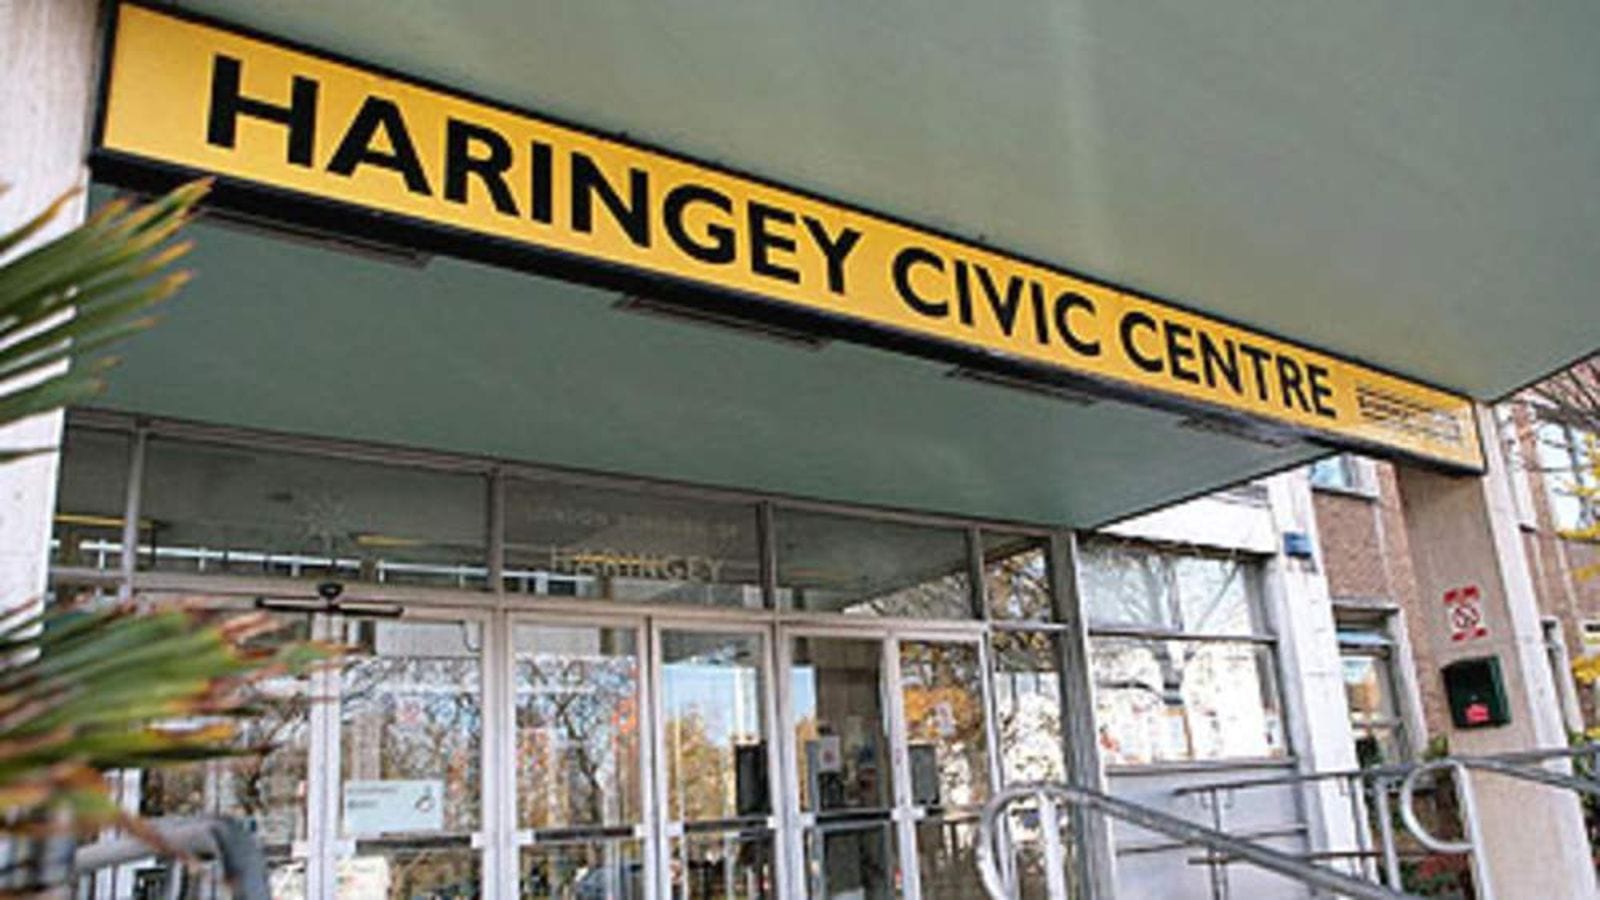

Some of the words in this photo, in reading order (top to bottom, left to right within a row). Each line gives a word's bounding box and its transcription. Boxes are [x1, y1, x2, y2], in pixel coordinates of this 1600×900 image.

[207, 53, 861, 294] HARINGEY
[892, 247, 1101, 357] CIVIC
[1119, 311, 1337, 419] CENTRE
